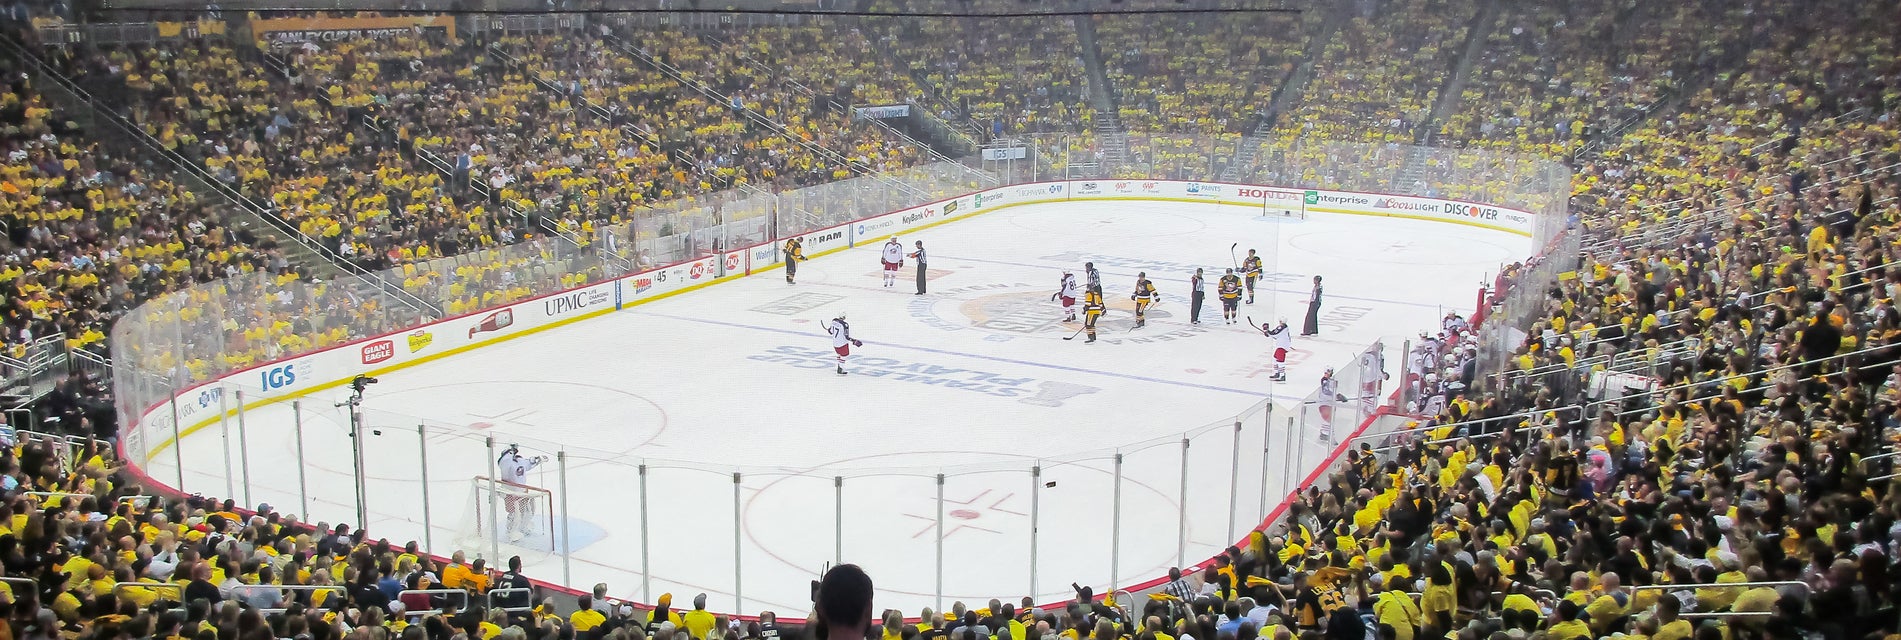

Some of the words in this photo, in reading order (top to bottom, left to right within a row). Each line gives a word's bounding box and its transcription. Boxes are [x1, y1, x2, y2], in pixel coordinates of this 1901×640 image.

[264, 31, 320, 44] SANLEY
[1237, 188, 1299, 201] HONDA
[1385, 198, 1414, 210] Coors
[1414, 204, 1439, 213] LIGHT
[1444, 203, 1498, 220] DISCOVER
[902, 212, 924, 225] KeyBank
[818, 231, 842, 243] RAM
[545, 291, 588, 316] UPMC
[363, 342, 391, 355] GIANT
[364, 350, 392, 362] EAGLE
[261, 364, 295, 392] IGS
